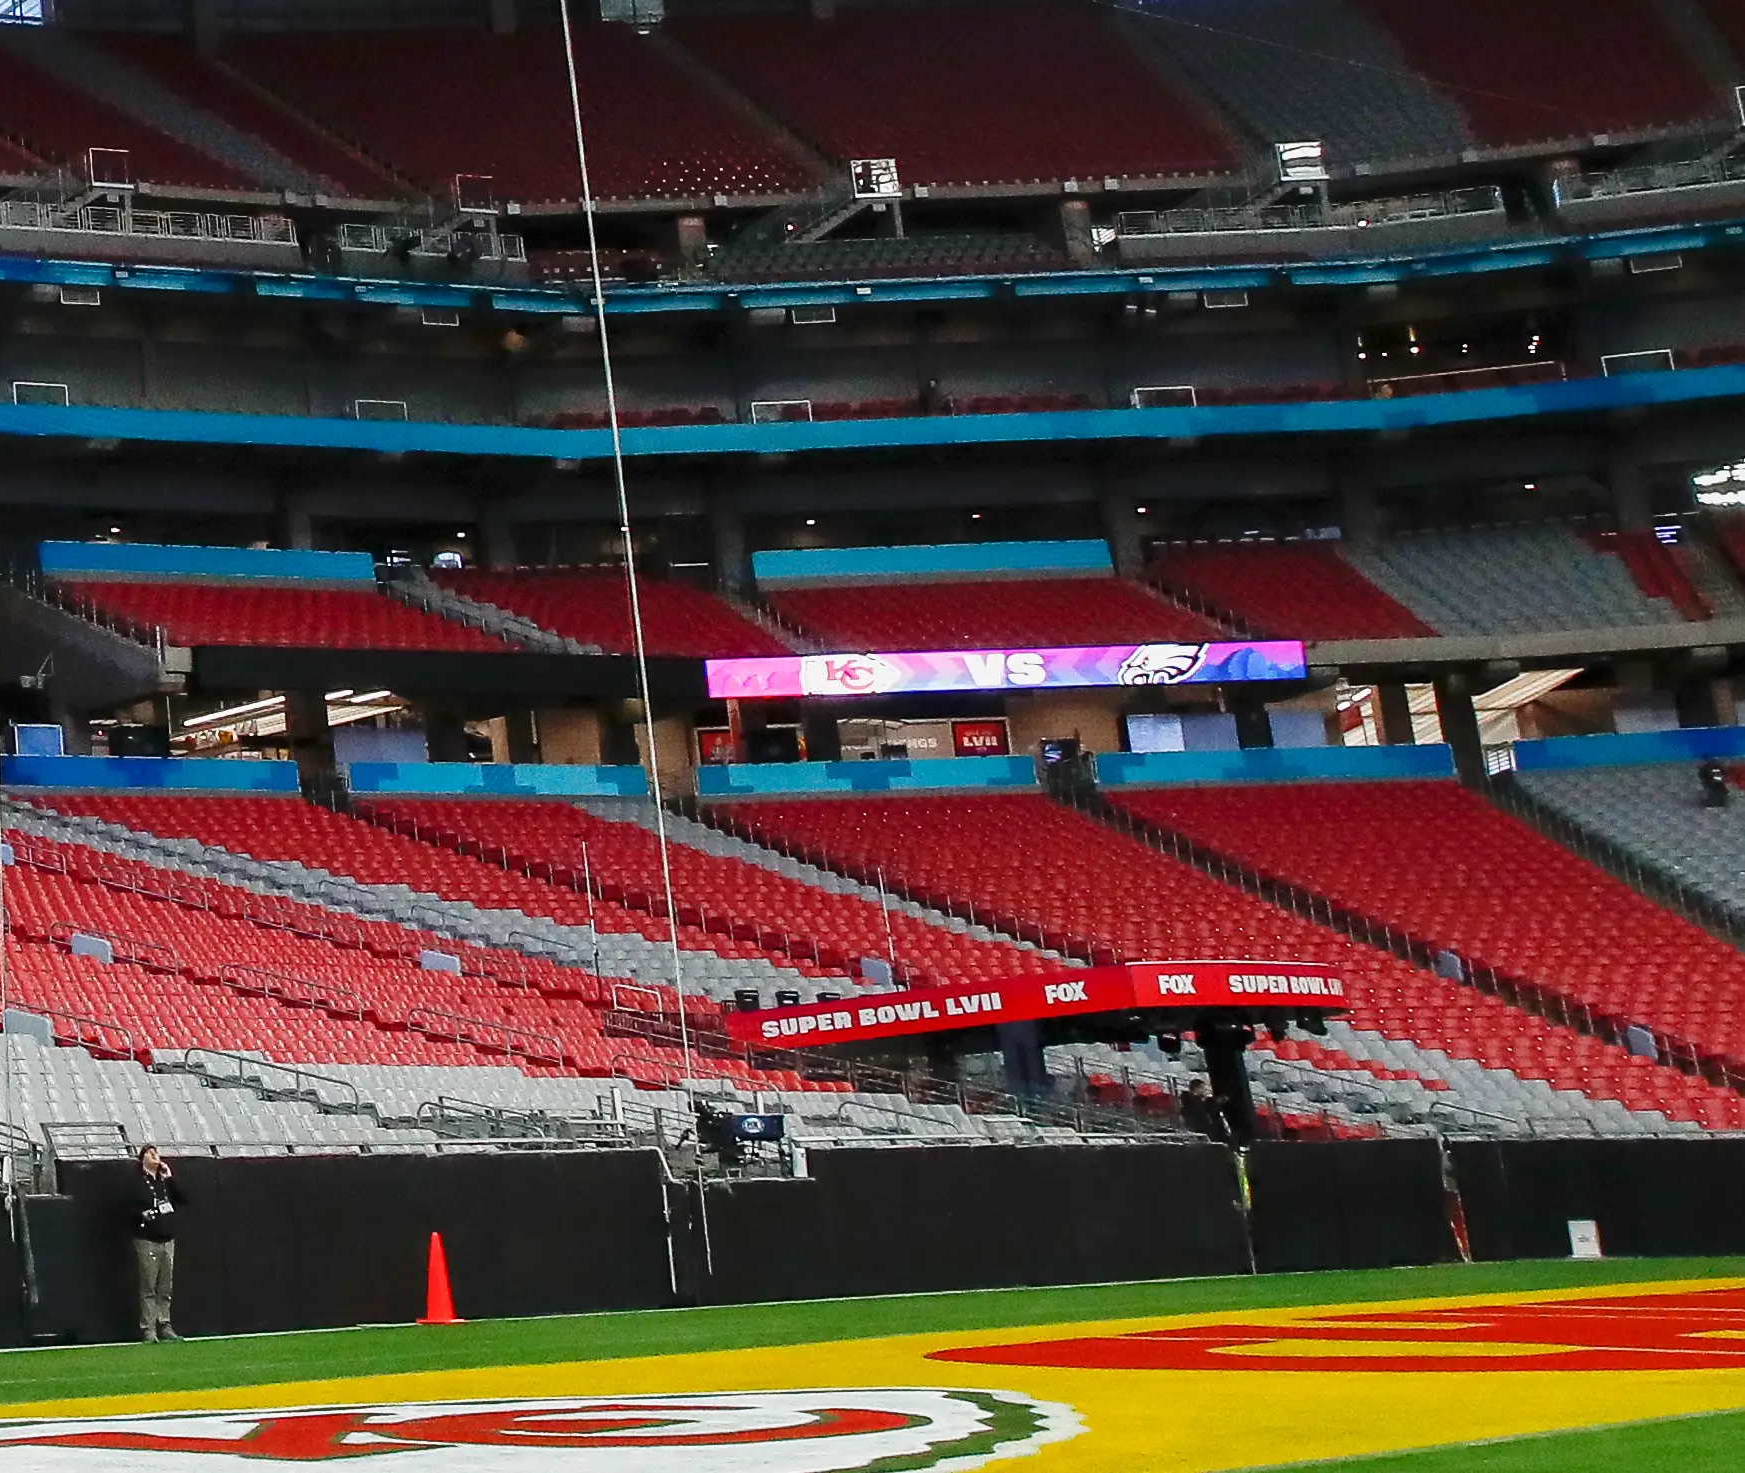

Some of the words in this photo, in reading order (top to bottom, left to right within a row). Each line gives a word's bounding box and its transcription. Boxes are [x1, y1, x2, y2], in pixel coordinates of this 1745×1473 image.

[826, 659, 874, 690] KC
[962, 653, 1047, 686] VS
[1043, 980, 1089, 1005] FOX
[1157, 974, 1197, 995] FOX
[1227, 974, 1290, 995] SUPER
[1290, 975, 1329, 996] BOWL
[760, 1011, 854, 1039] SUPER
[858, 1000, 940, 1027] BOWL
[944, 992, 1003, 1016] LVII
